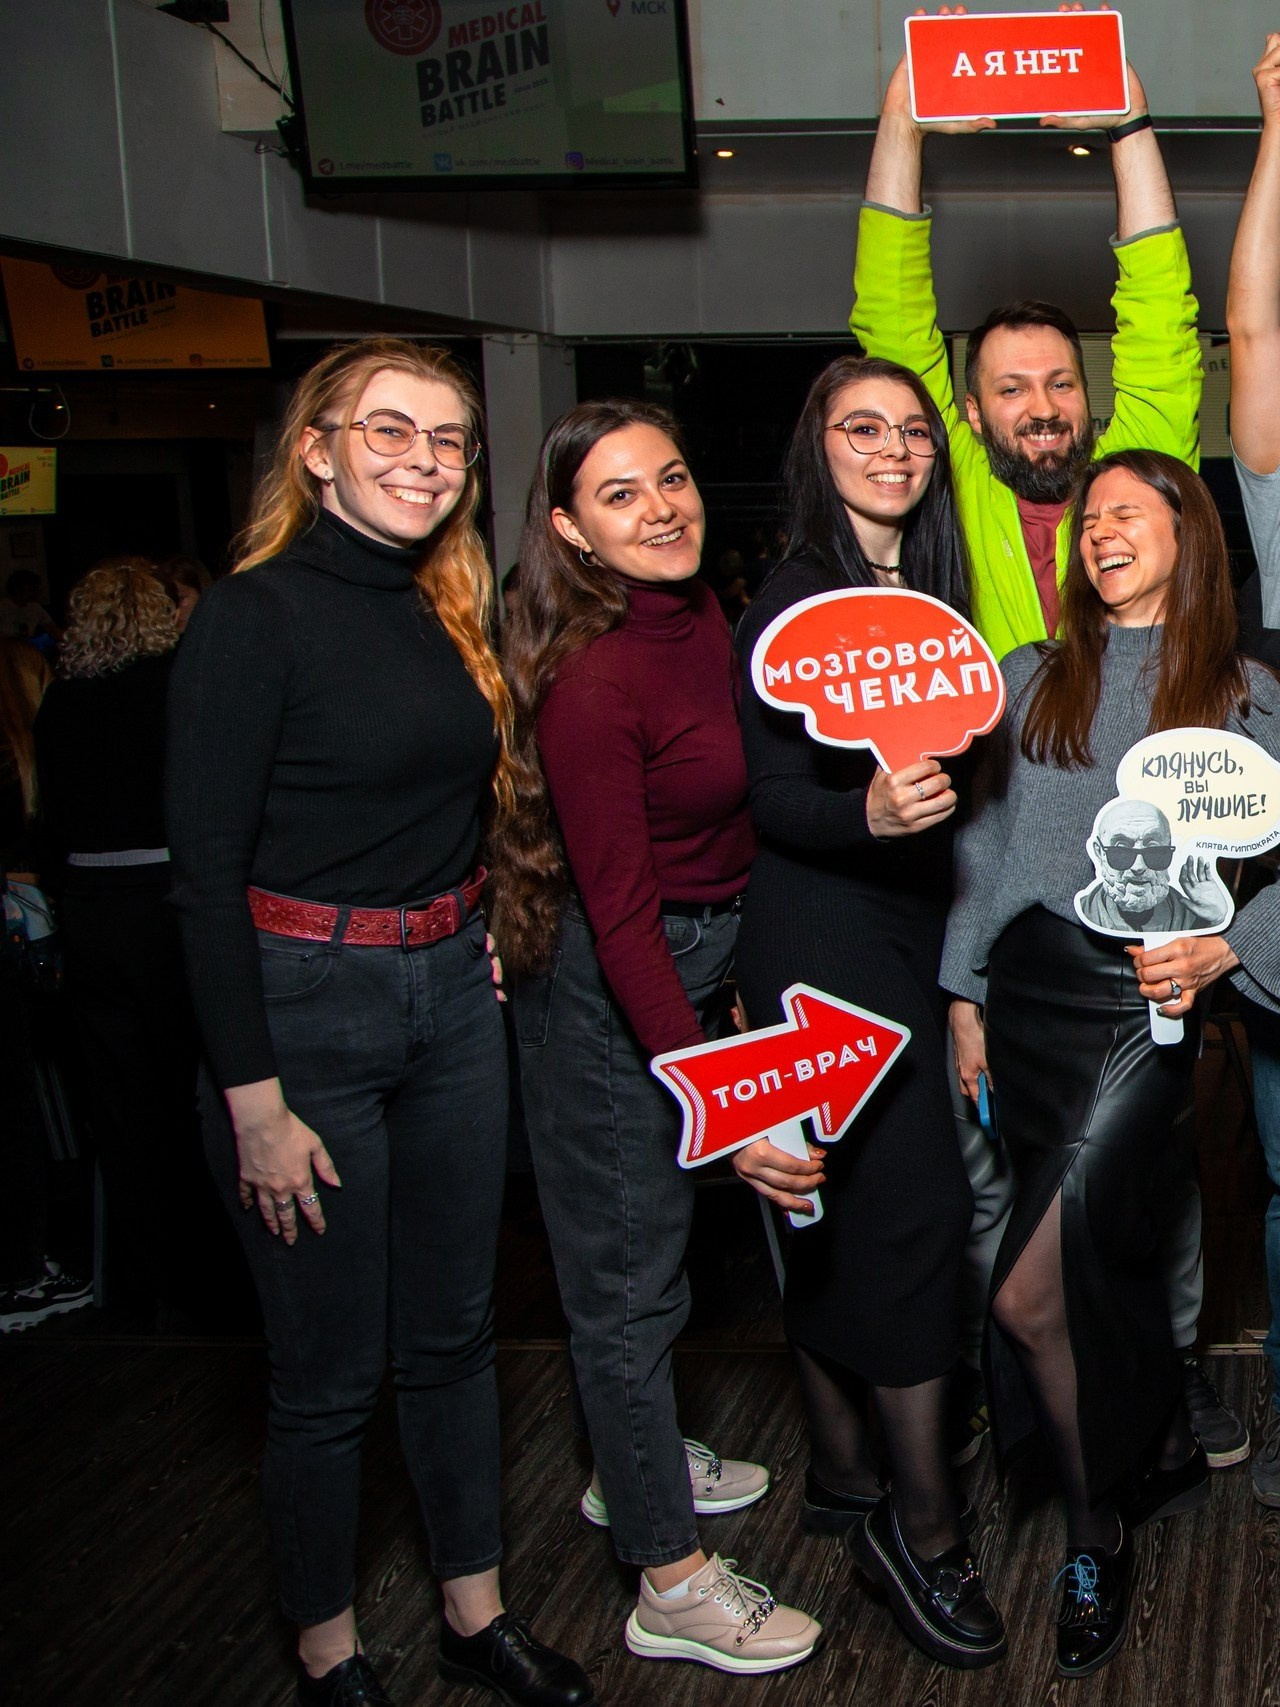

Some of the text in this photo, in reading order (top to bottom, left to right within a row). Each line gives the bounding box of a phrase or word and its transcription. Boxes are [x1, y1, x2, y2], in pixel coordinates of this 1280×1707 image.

[447, 0, 547, 48] MEDICAL
[415, 23, 550, 101] BRAIN
[952, 48, 1083, 77] А Я НЕТ
[420, 82, 507, 128] BATTLE
[86, 279, 176, 321] BRAIN
[90, 308, 149, 338] BATTLE
[764, 628, 973, 687] МОЗГОВОЙ
[824, 661, 992, 714] ЧЕКАП
[1141, 749, 1244, 779] КЛЯНУСЬ,
[1177, 793, 1267, 822] ЛУЧШИЕ!
[1184, 780, 1209, 794] ВЫ
[1196, 830, 1280, 852] КЛЯТВА ГИППОКРАТА
[712, 1035, 878, 1109] ТОП-ВРАЧ
